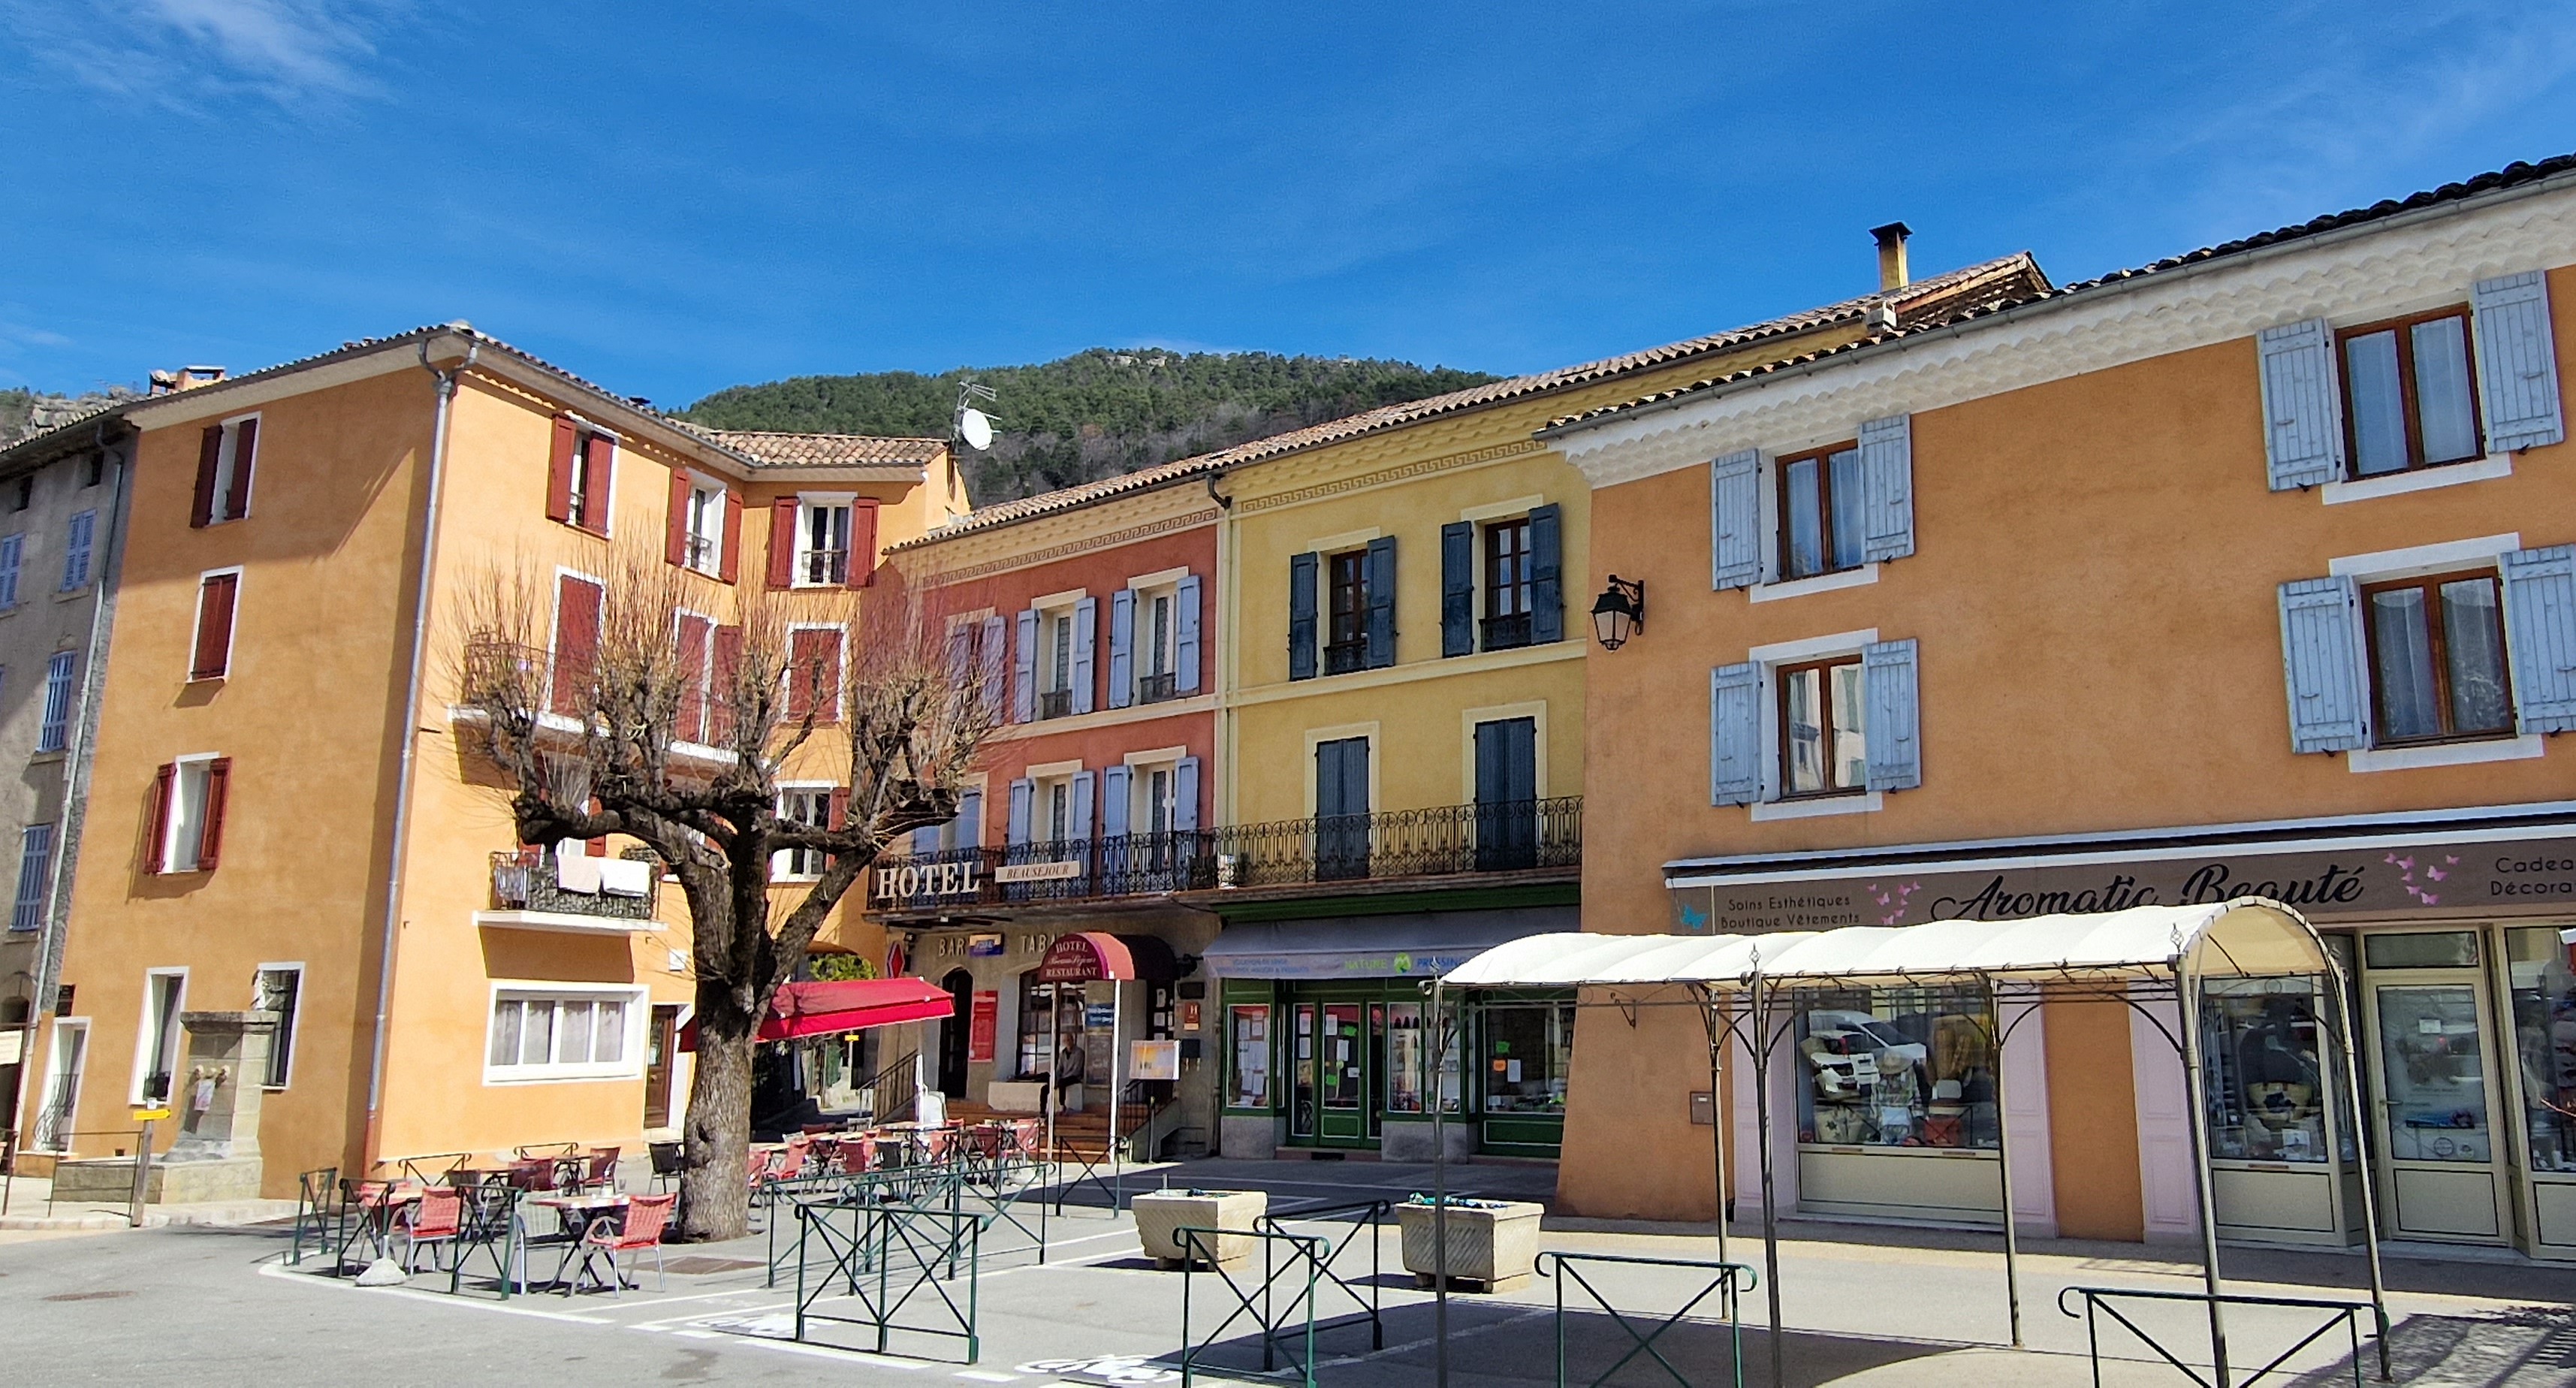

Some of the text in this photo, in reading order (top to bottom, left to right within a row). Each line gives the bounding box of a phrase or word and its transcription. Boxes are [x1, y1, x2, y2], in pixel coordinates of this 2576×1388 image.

[1006, 864, 1069, 879] BEAUSEJOUR
[2496, 857, 2576, 873] Cadea
[876, 861, 980, 900] HOTEL
[2491, 881, 2576, 895] Décora
[1931, 863, 2365, 921] Aromatic Beauté
[1729, 896, 1851, 910] Soins Esthétiques
[1721, 913, 1860, 928] Boutique Vêtements
[939, 938, 966, 956] BAR
[1055, 941, 1088, 953] HOTEL
[1345, 958, 1388, 970] NATURE
[1417, 956, 1467, 967] PRSING
[1045, 967, 1097, 978] RESTAURANT
